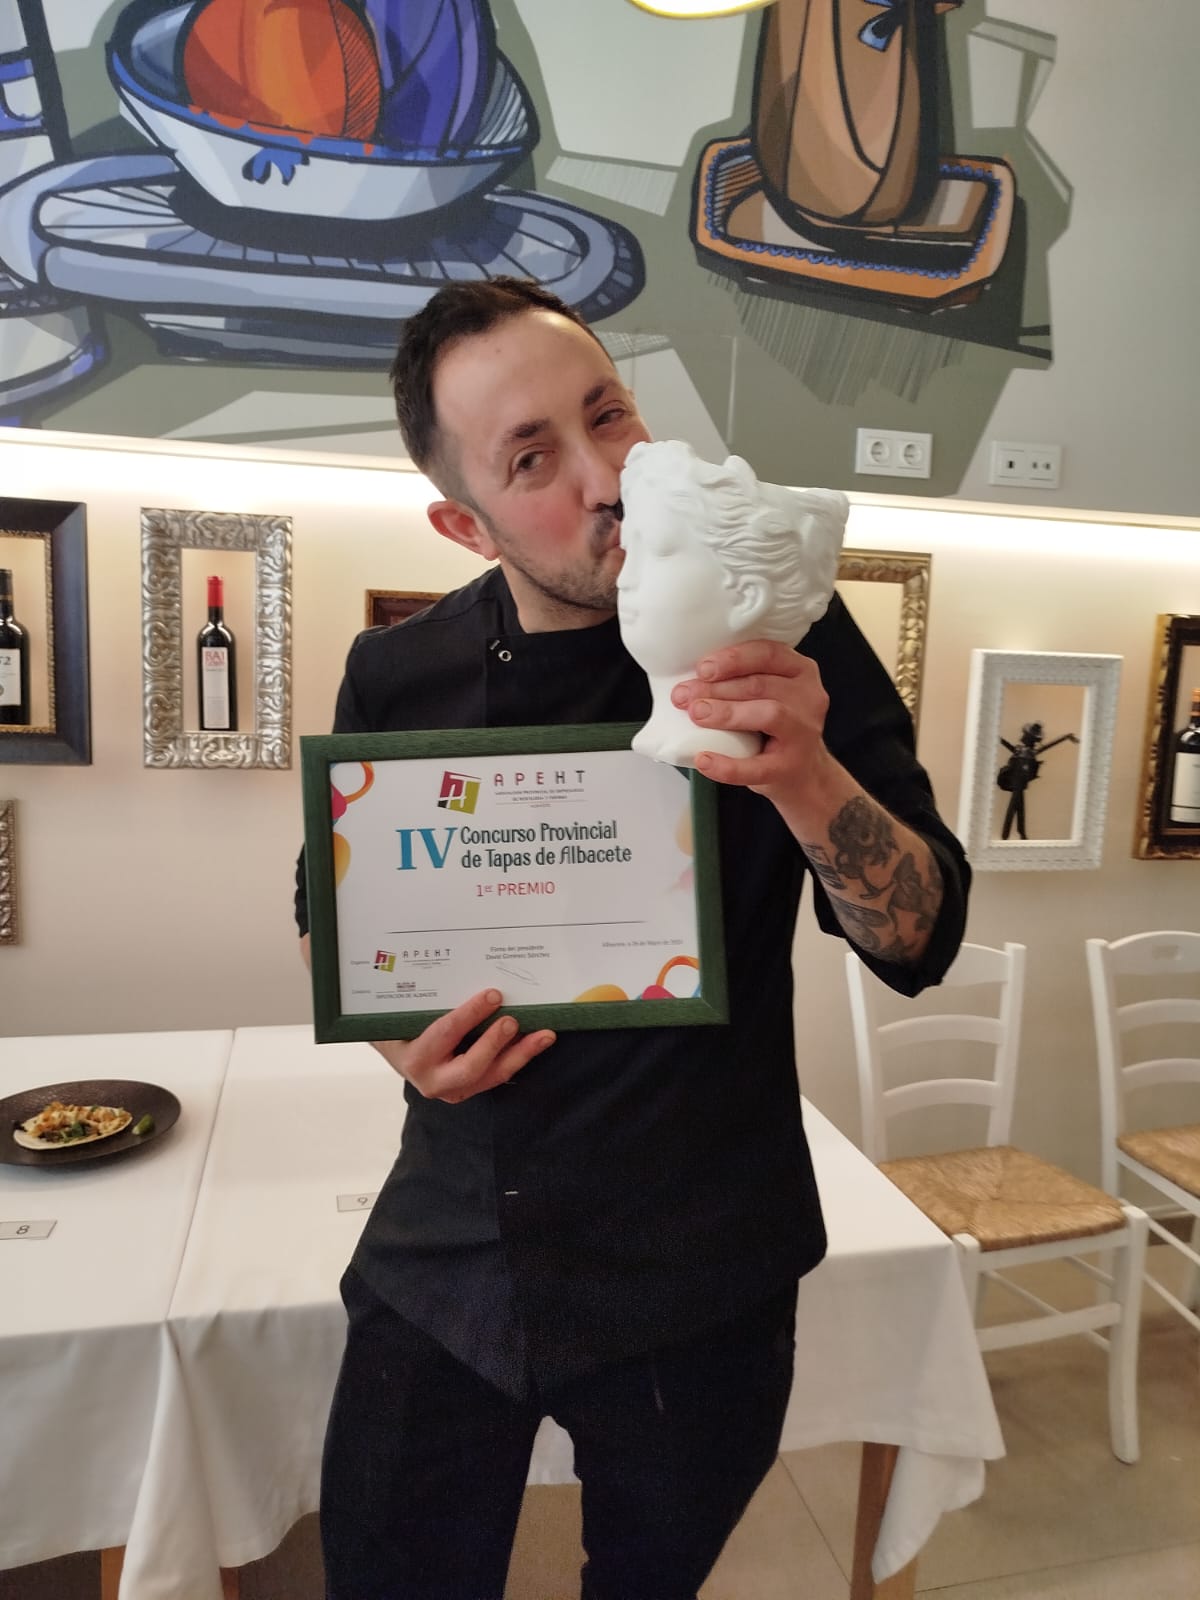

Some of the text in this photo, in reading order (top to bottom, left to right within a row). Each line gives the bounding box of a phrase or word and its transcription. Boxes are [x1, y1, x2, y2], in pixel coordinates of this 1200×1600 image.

[494, 769, 585, 787] APEHT
[460, 820, 617, 845] Concurso Provincial
[395, 826, 458, 871] IV
[461, 845, 632, 873] de Tapas de Albacete
[497, 881, 556, 897] PREMIO
[403, 948, 450, 959] APEHT
[357, 1197, 368, 1206] 9
[16, 1225, 30, 1235] 8
